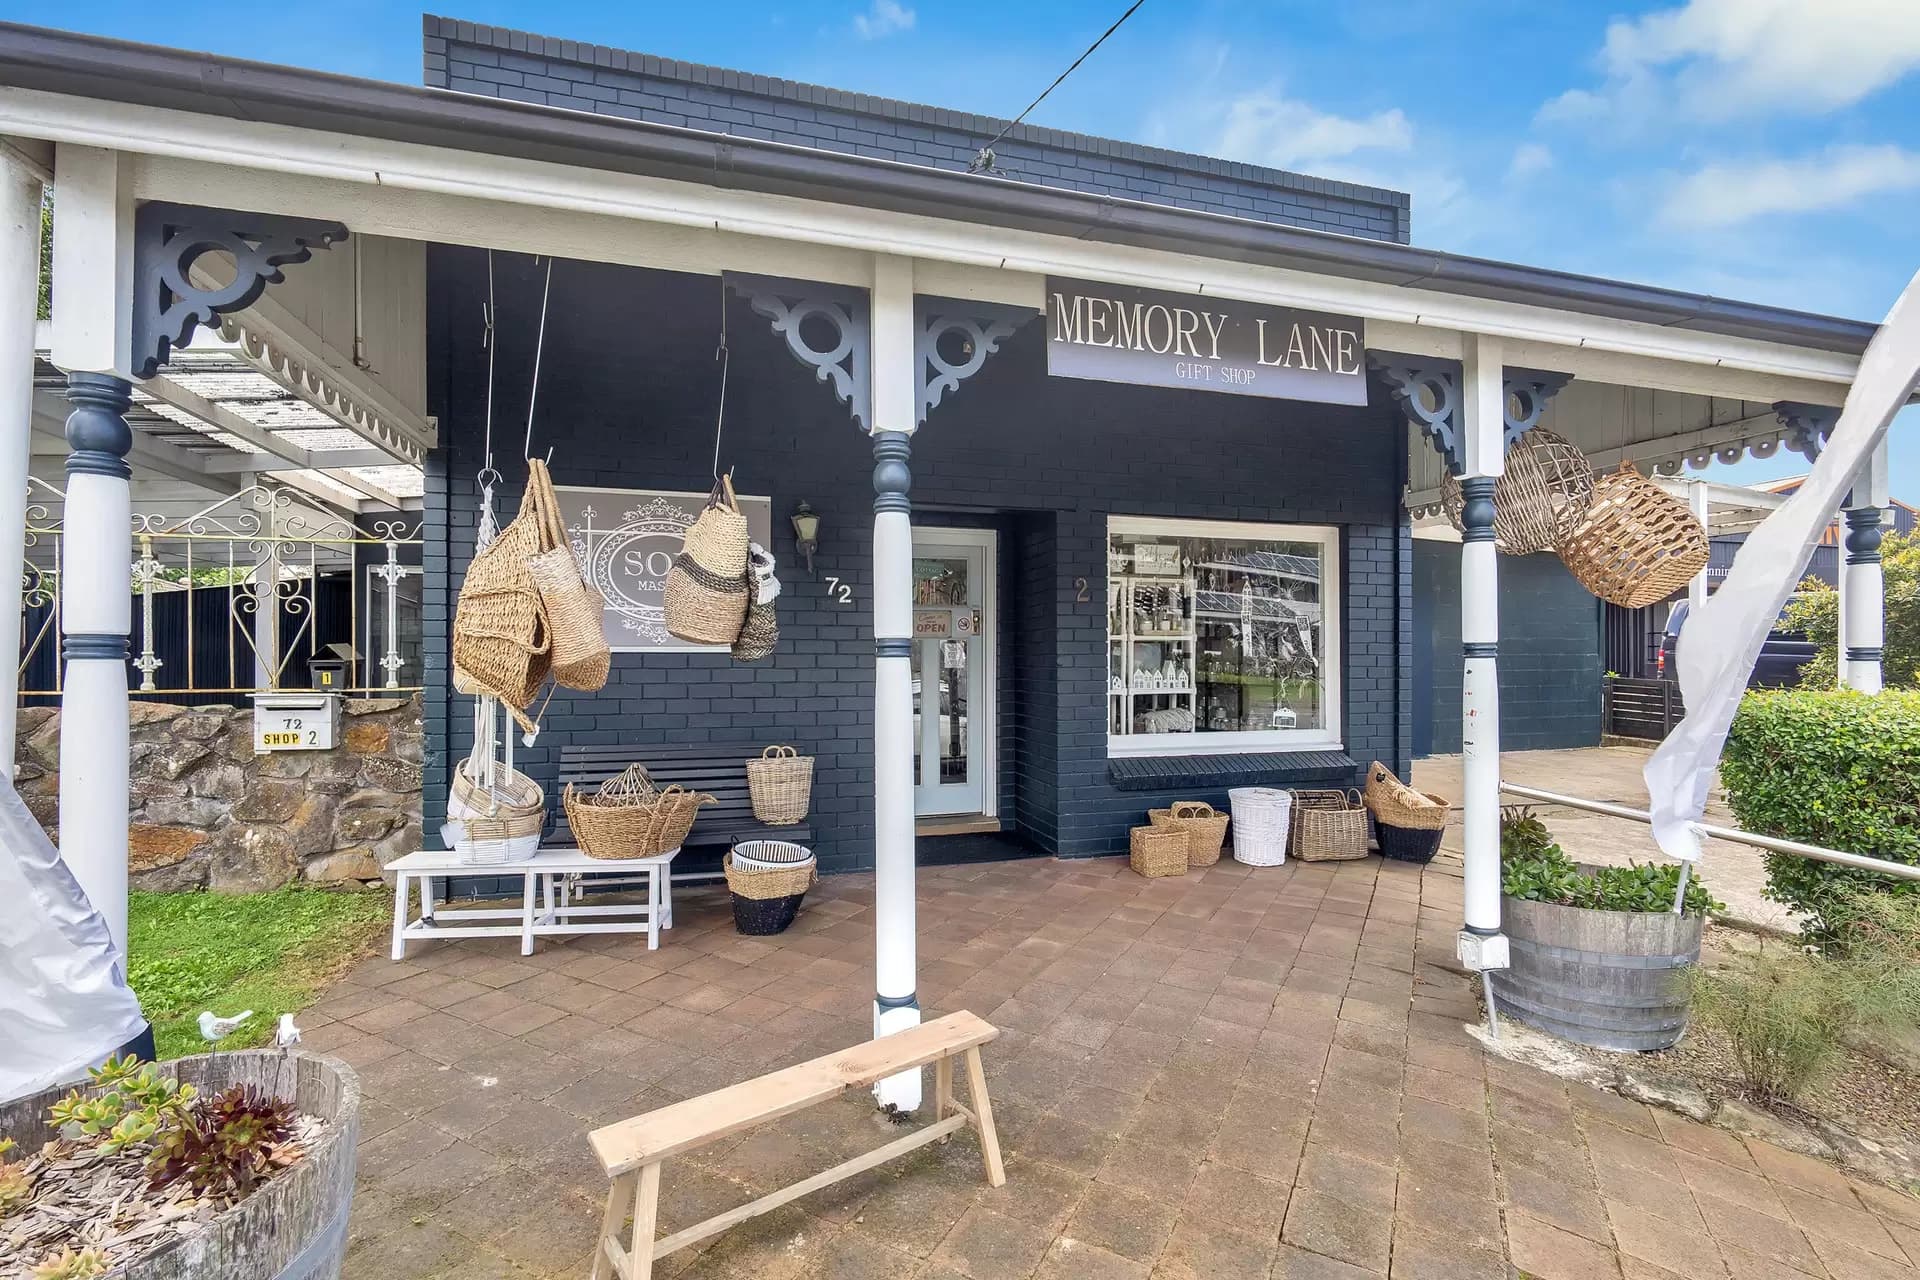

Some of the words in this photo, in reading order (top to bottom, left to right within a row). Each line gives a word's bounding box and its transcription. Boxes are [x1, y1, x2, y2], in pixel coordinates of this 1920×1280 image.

[1053, 293, 1228, 360] MEMORY
[1256, 319, 1360, 375] LANE
[1175, 362, 1212, 380] GIFT
[1221, 368, 1256, 385] SHOP
[825, 576, 852, 604] 72
[1075, 575, 1089, 602] 2
[916, 623, 946, 633] OPEN
[283, 719, 302, 729] 72
[264, 733, 299, 745] SHOP
[309, 731, 317, 745] 2
